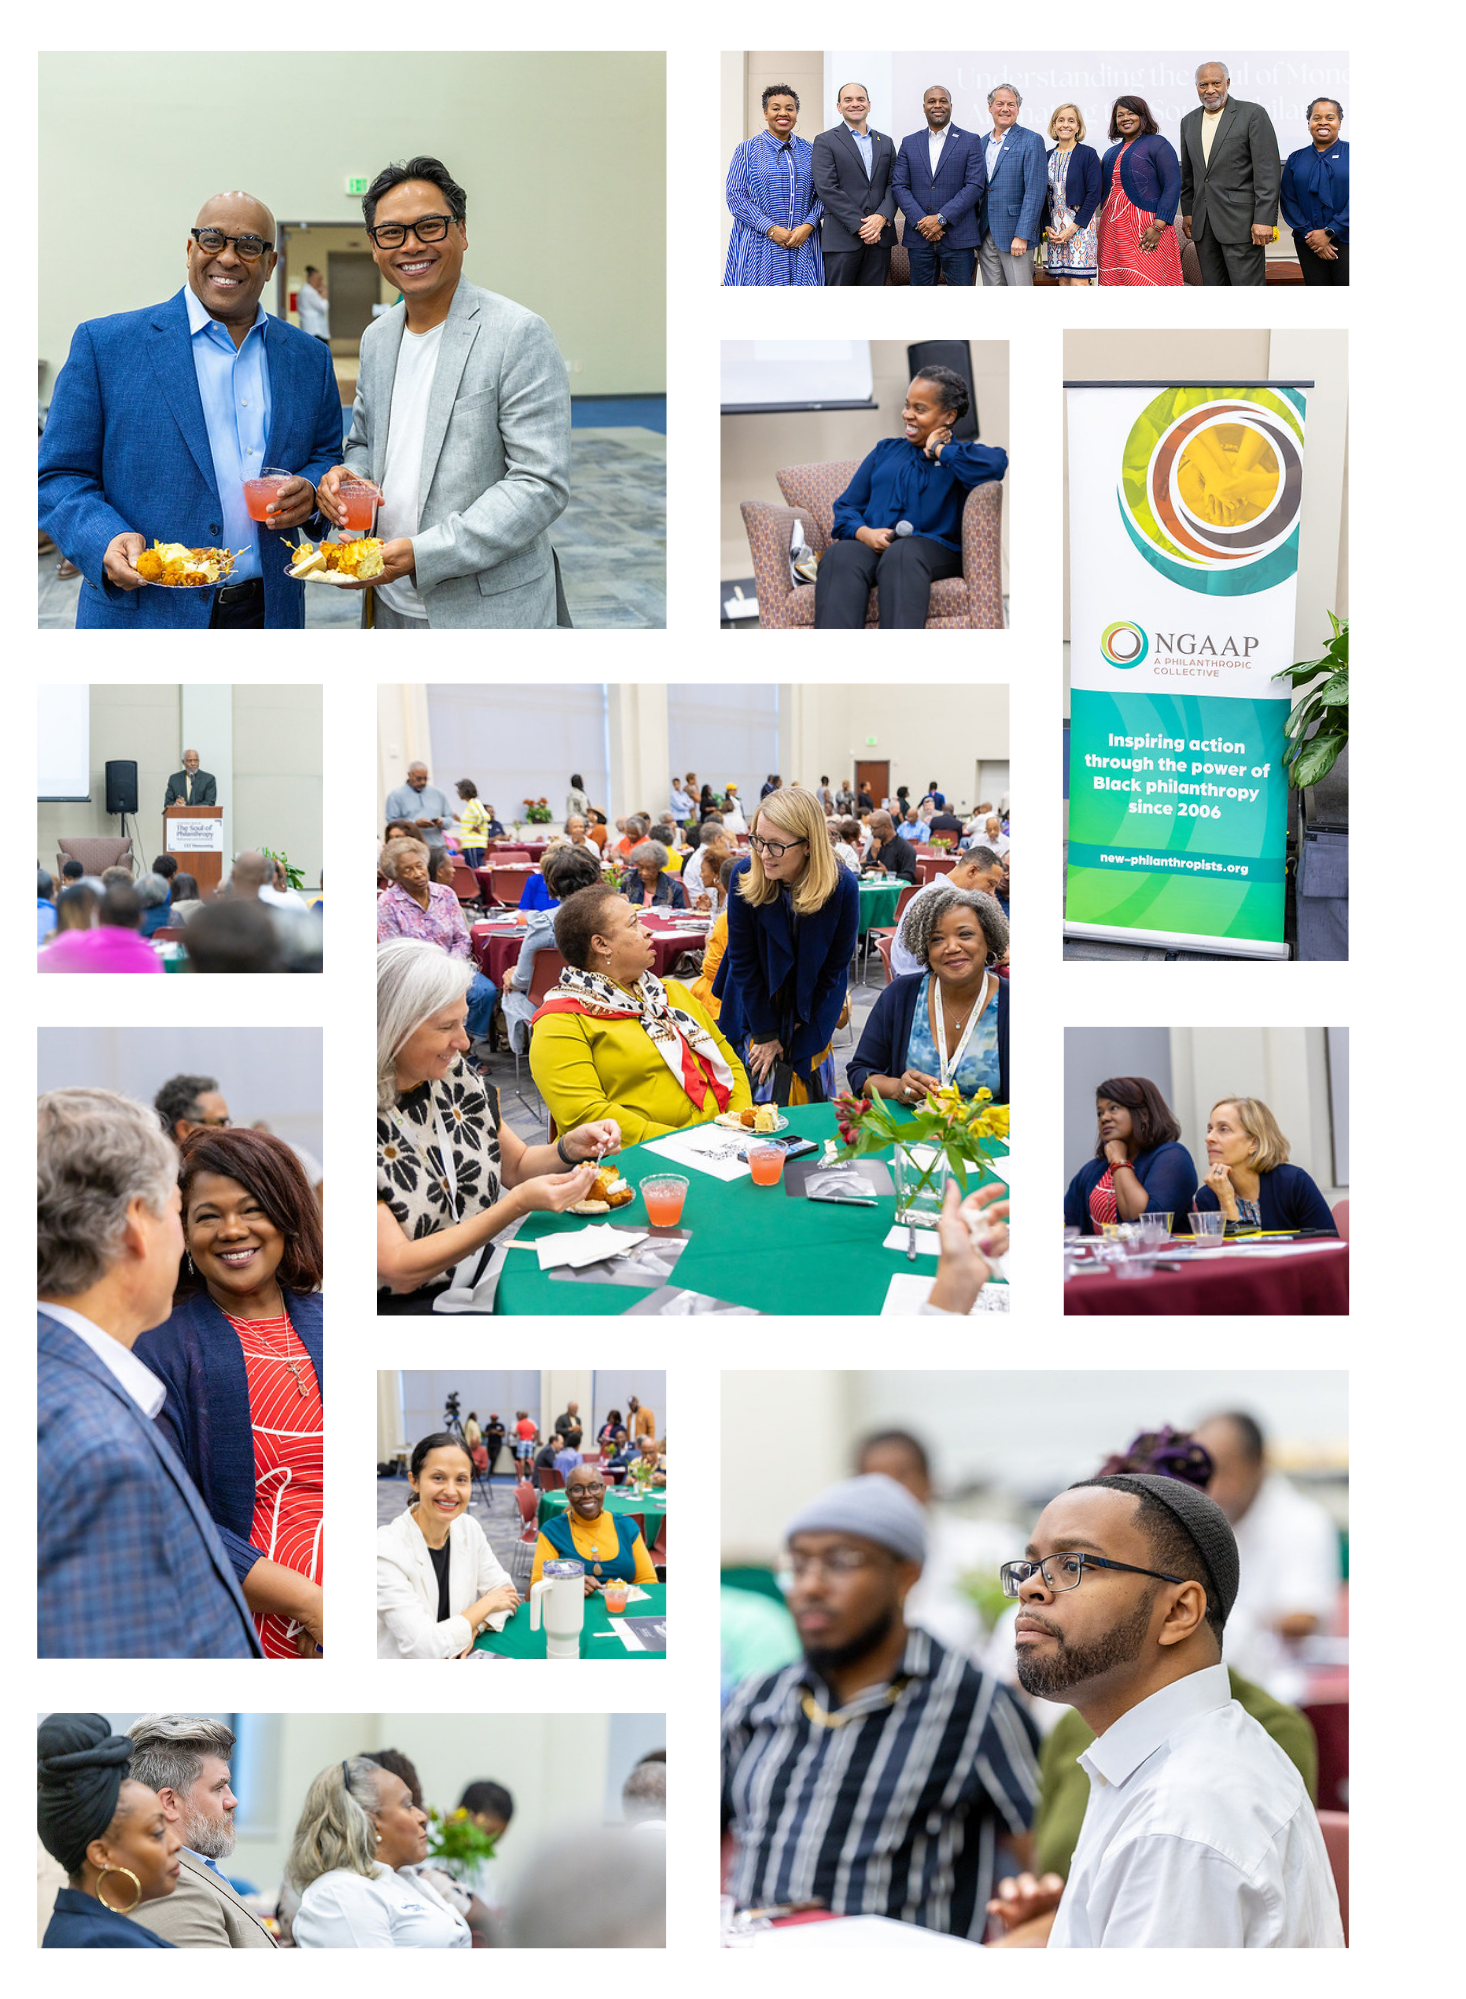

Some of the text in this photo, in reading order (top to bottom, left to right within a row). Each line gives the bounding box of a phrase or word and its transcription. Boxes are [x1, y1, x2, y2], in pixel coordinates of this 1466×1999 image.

[957, 62, 1145, 95] Understanding
[1150, 61, 1190, 87] the
[1255, 61, 1284, 86] of
[1155, 632, 1259, 657] NGAAP
[1153, 657, 1252, 670] A PHILANTHROPIC
[1153, 667, 1219, 677] COLLECTIVE
[1108, 733, 1246, 754] Inspiring action
[1084, 753, 1271, 778] through the power of
[1093, 776, 1260, 802] Black philanthropy
[1128, 798, 1222, 820] since 2006
[1100, 853, 1249, 876] new-philanthropists.org
